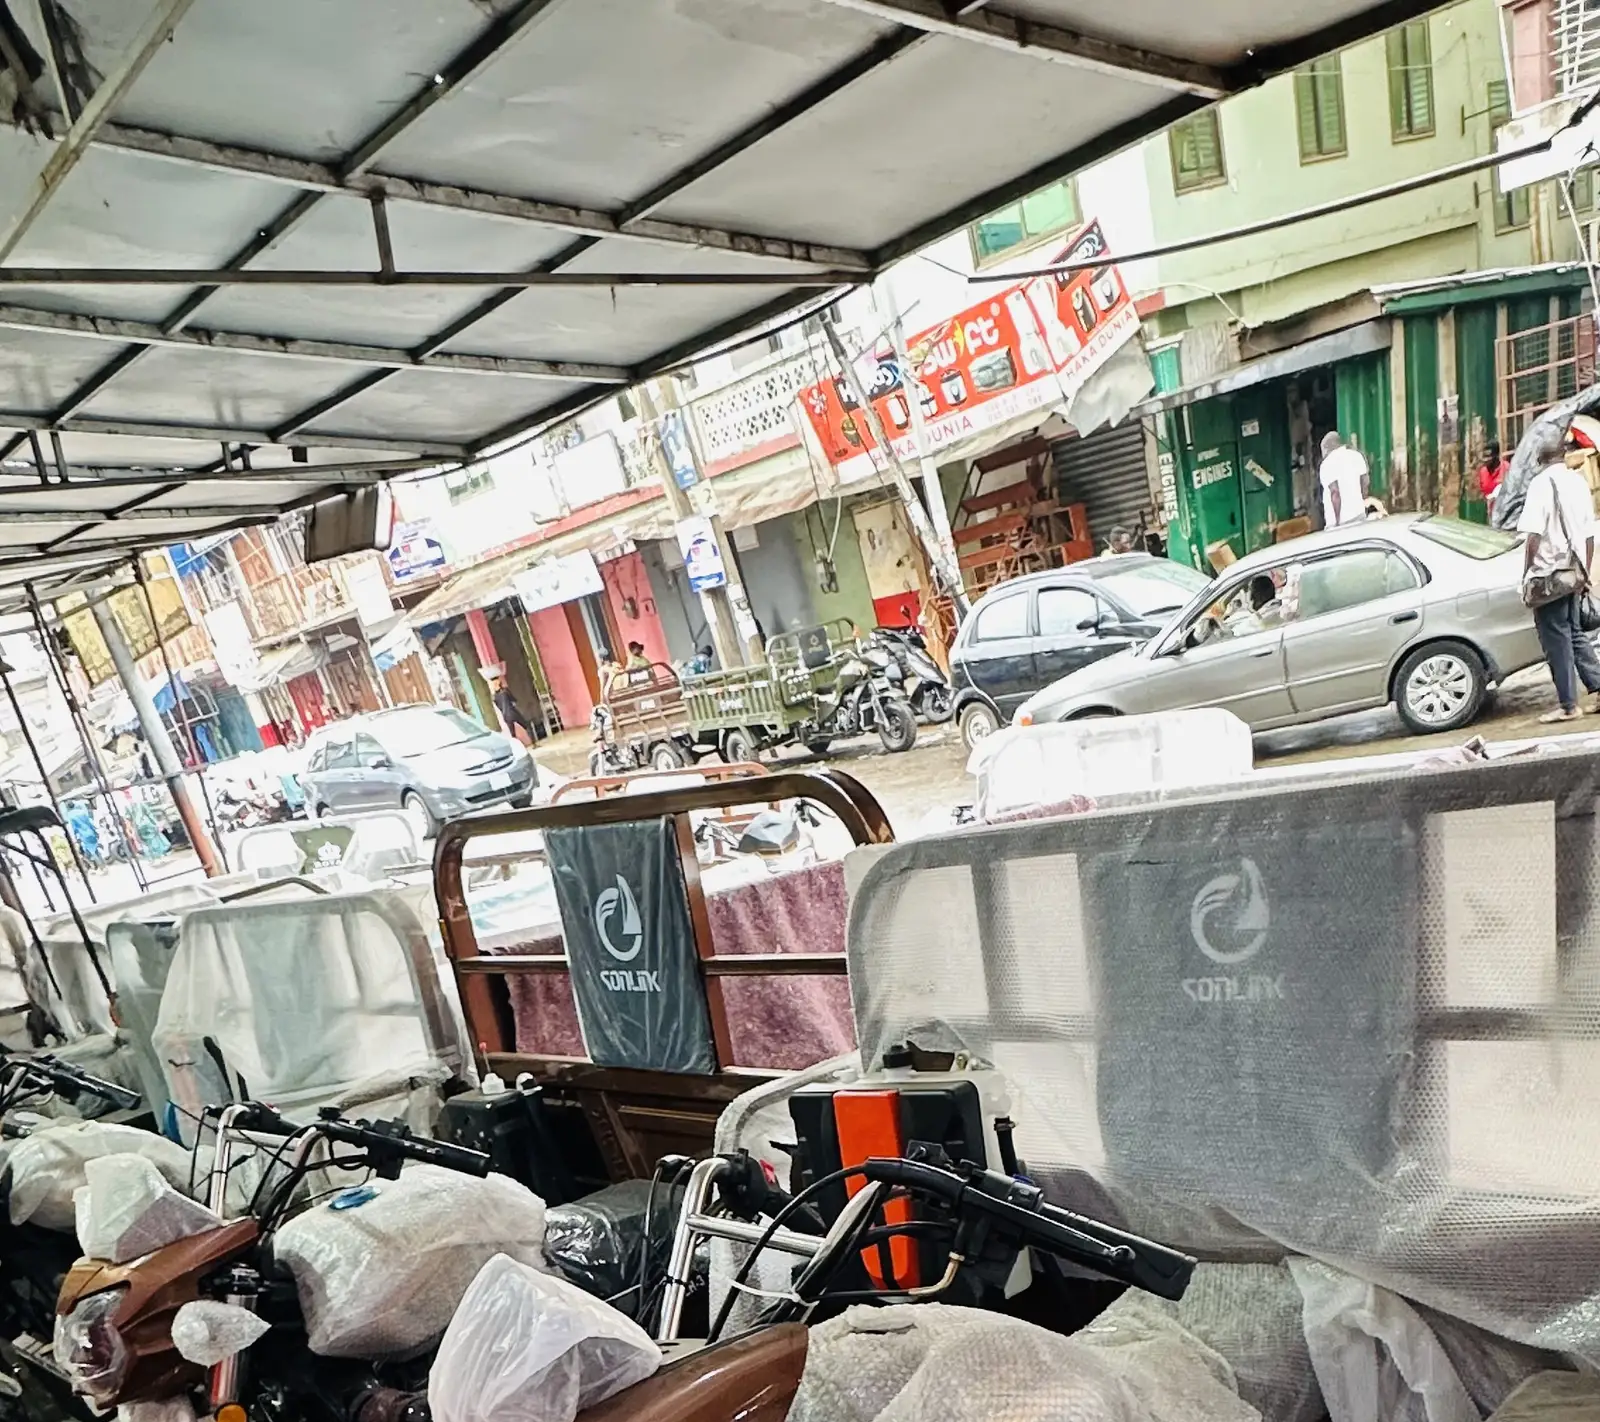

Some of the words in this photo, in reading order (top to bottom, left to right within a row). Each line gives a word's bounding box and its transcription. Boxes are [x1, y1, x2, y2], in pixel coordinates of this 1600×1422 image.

[1065, 346, 1099, 380] HAKA
[1098, 310, 1134, 347] DUNIA
[872, 440, 918, 467] HKA
[1192, 460, 1233, 490] ENGINES
[1158, 452, 1180, 521] ENGINES
